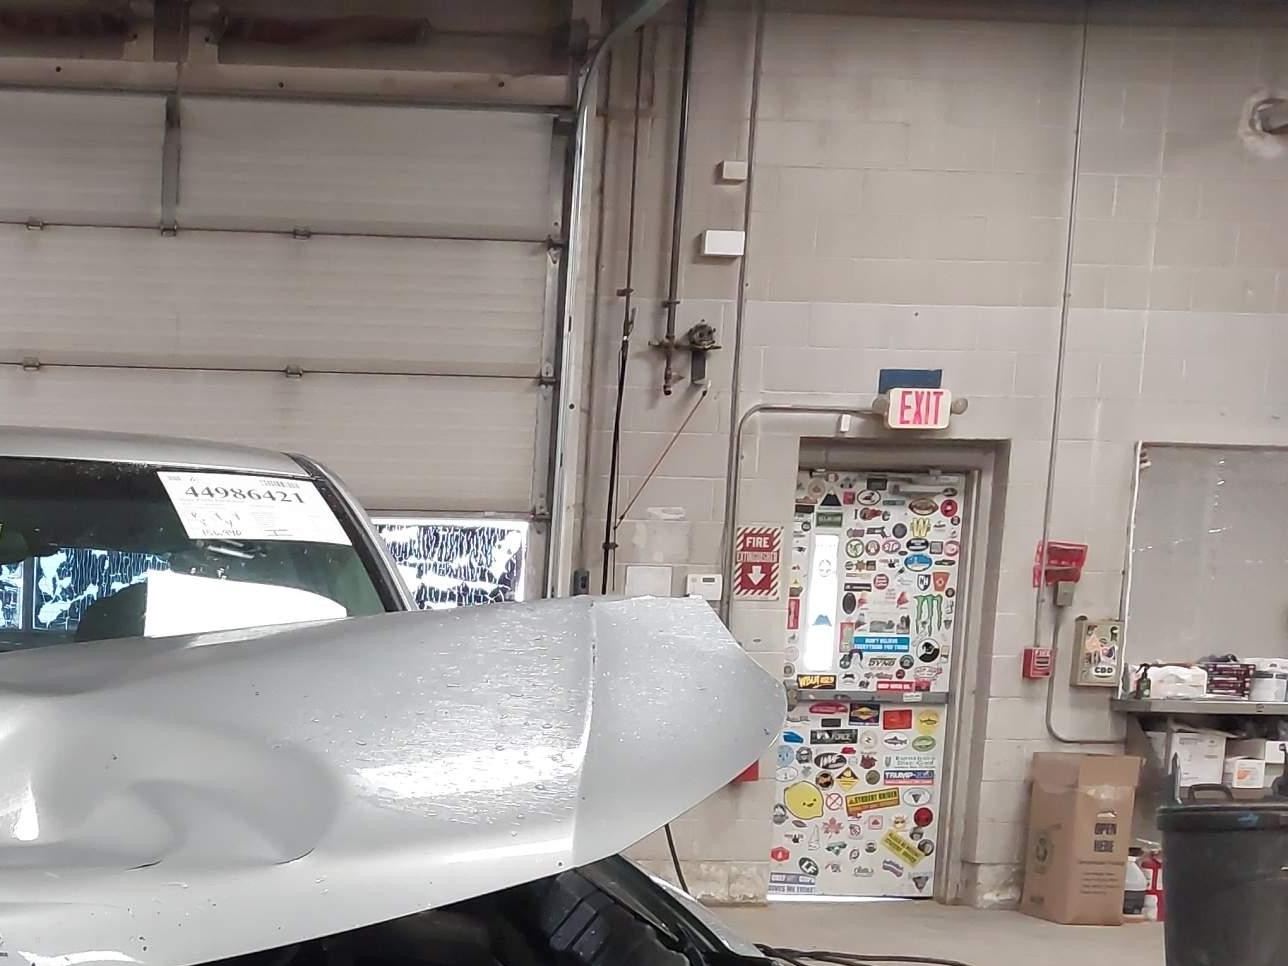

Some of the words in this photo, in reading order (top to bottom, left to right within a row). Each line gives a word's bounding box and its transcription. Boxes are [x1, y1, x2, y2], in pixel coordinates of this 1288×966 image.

[899, 391, 943, 425] EXIT
[185, 485, 305, 504] 44986421
[746, 536, 770, 548] FIRE
[1095, 823, 1117, 835] OPEN
[1094, 840, 1114, 852] HERE
